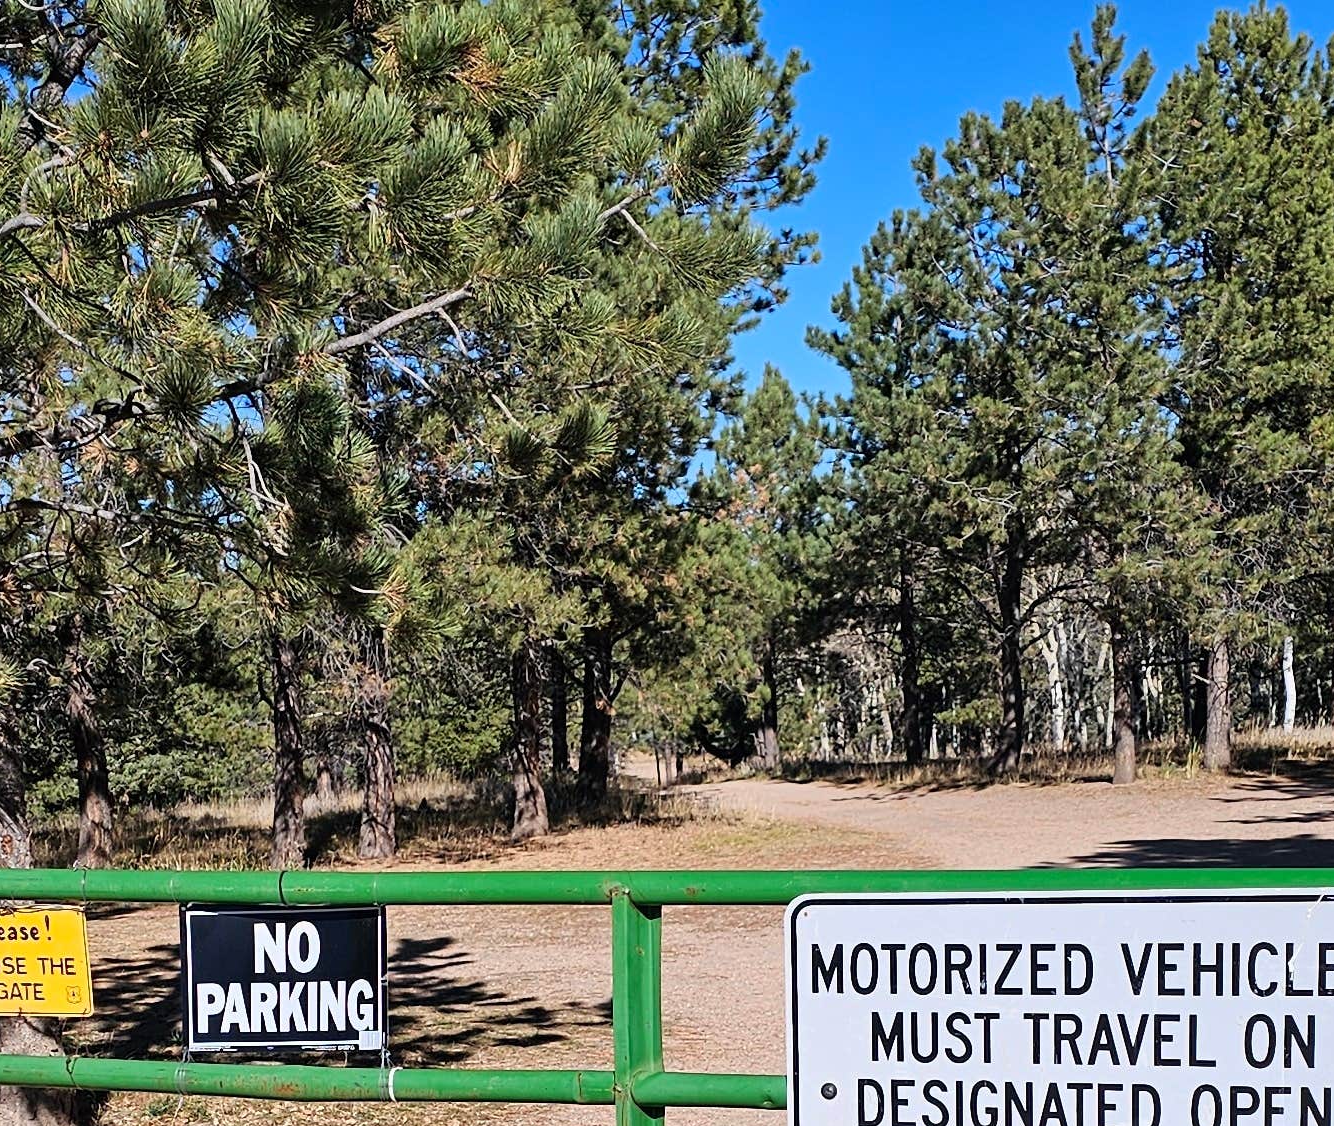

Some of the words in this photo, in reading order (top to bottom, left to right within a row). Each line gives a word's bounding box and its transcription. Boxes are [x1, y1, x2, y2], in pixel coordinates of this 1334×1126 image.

[36, 957, 77, 976] THE
[253, 920, 321, 974] NO
[811, 942, 1094, 996] MOTORIZED
[196, 978, 375, 1034] PARKING
[871, 1011, 1001, 1064] MUST
[1023, 1012, 1217, 1068] TRAVEL
[1244, 1013, 1316, 1070] ON
